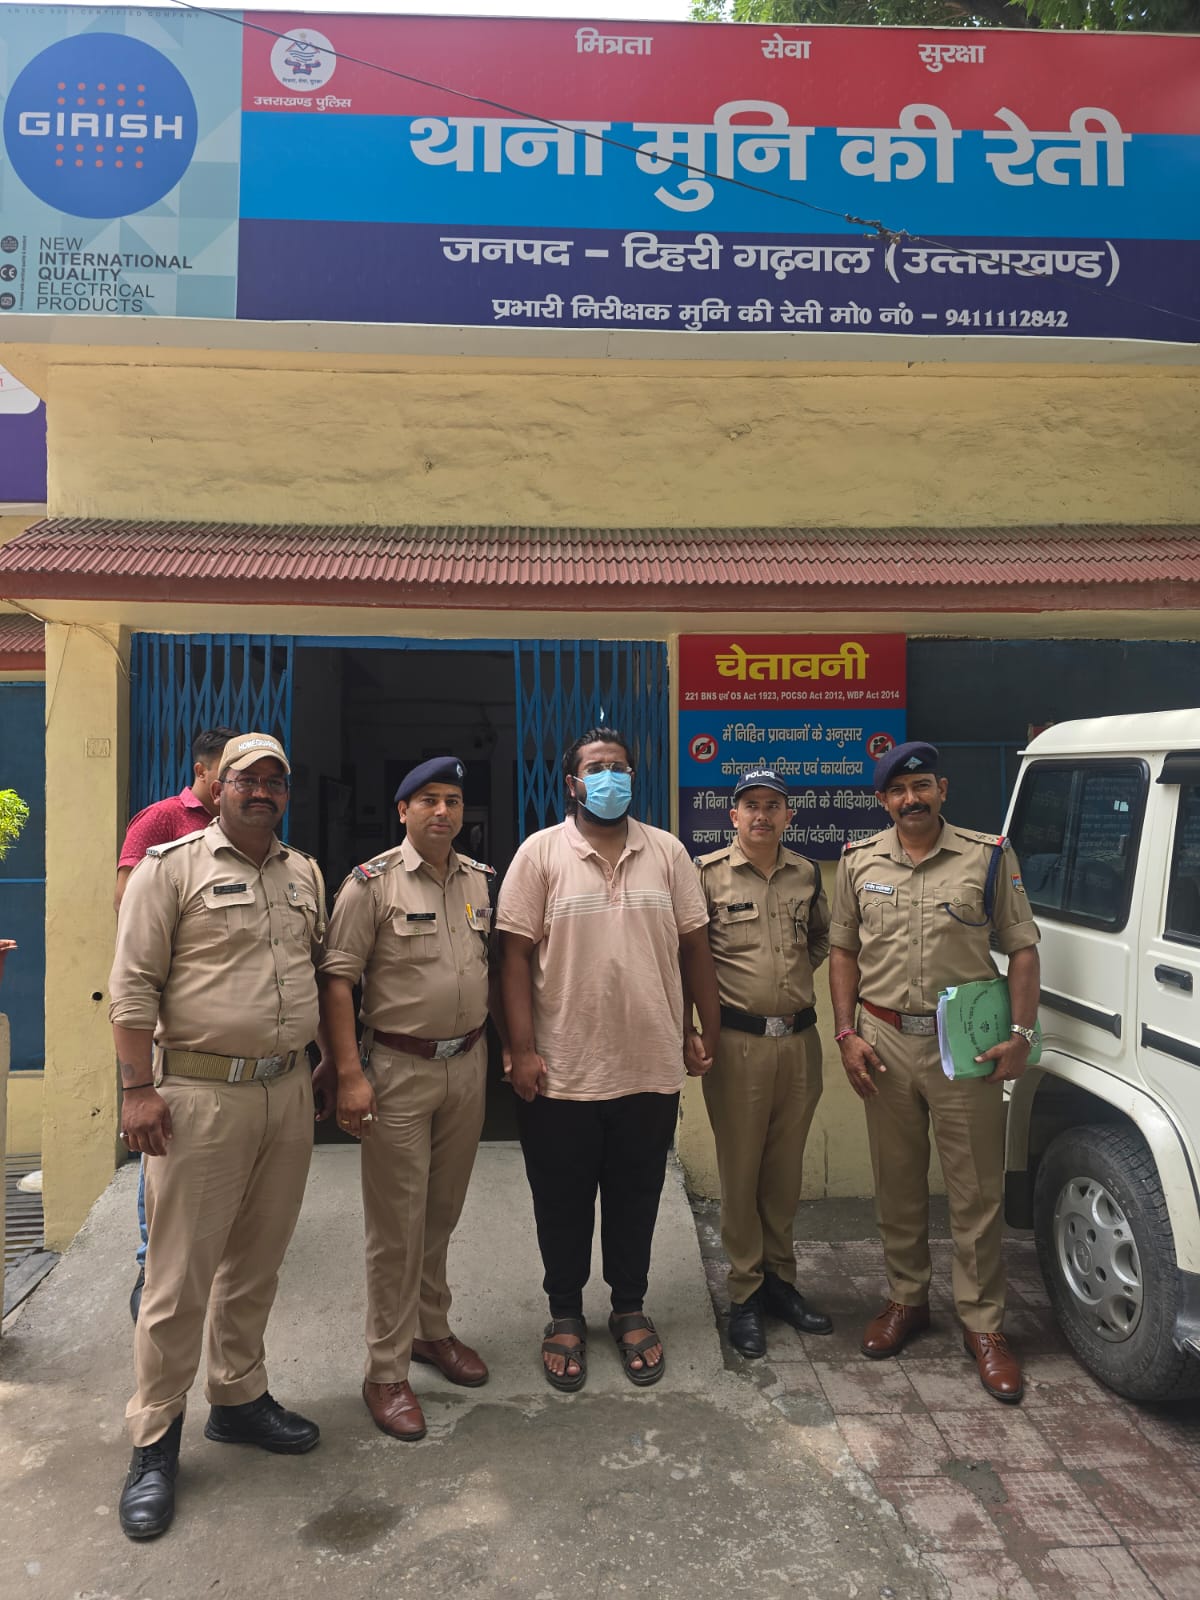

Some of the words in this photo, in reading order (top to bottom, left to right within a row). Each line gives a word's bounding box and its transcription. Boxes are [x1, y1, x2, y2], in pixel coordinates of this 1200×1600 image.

[575, 27, 653, 56] मित्रता
[761, 33, 812, 60] सेवा
[918, 43, 986, 73] सुरक्षा
[253, 96, 313, 108] उत्तराखण्ड
[315, 95, 353, 111] पुलिस
[18, 111, 183, 140] GIRISH
[409, 117, 611, 177] थाना
[633, 99, 815, 213] मुनि
[836, 103, 963, 183] की
[982, 106, 1133, 187] रेती
[40, 237, 83, 251] NEW
[39, 252, 193, 269] INTERNATIONAL
[440, 237, 574, 266] जनपद
[622, 231, 723, 272] टिहरी
[733, 245, 874, 280] गढ़वाल
[38, 267, 122, 282] QUALITY
[37, 282, 155, 298] ELECTRICAL
[37, 297, 143, 312] PRODUCTS
[492, 293, 564, 320] प्रभारी
[571, 294, 672, 322] निरीक्षक
[679, 298, 731, 331] मुनि
[738, 299, 774, 323] की
[780, 299, 823, 324] रेती
[945, 309, 1069, 328] 9411112842
[715, 641, 869, 681] चेतावनी
[685, 691, 698, 700] 221
[701, 691, 717, 700] BNS
[743, 691, 756, 700] Act
[758, 691, 779, 702] 1923,
[781, 691, 807, 700] POCSO
[809, 691, 822, 700] Act
[824, 691, 845, 701] 2012,
[866, 690, 879, 700] Act
[881, 690, 900, 699] 2014
[722, 724, 734, 741] में
[734, 723, 765, 743] निहित
[767, 723, 811, 743] प्रावधानों
[811, 723, 823, 741] के
[825, 727, 863, 748] अनुसार
[802, 757, 819, 775] एवं
[820, 756, 863, 775] कार्यालय
[745, 769, 776, 781] POLICE
[693, 792, 705, 809] में
[705, 791, 728, 810] बिना
[787, 790, 817, 815] नुमति
[819, 791, 831, 809] के
[692, 829, 721, 843] करना
